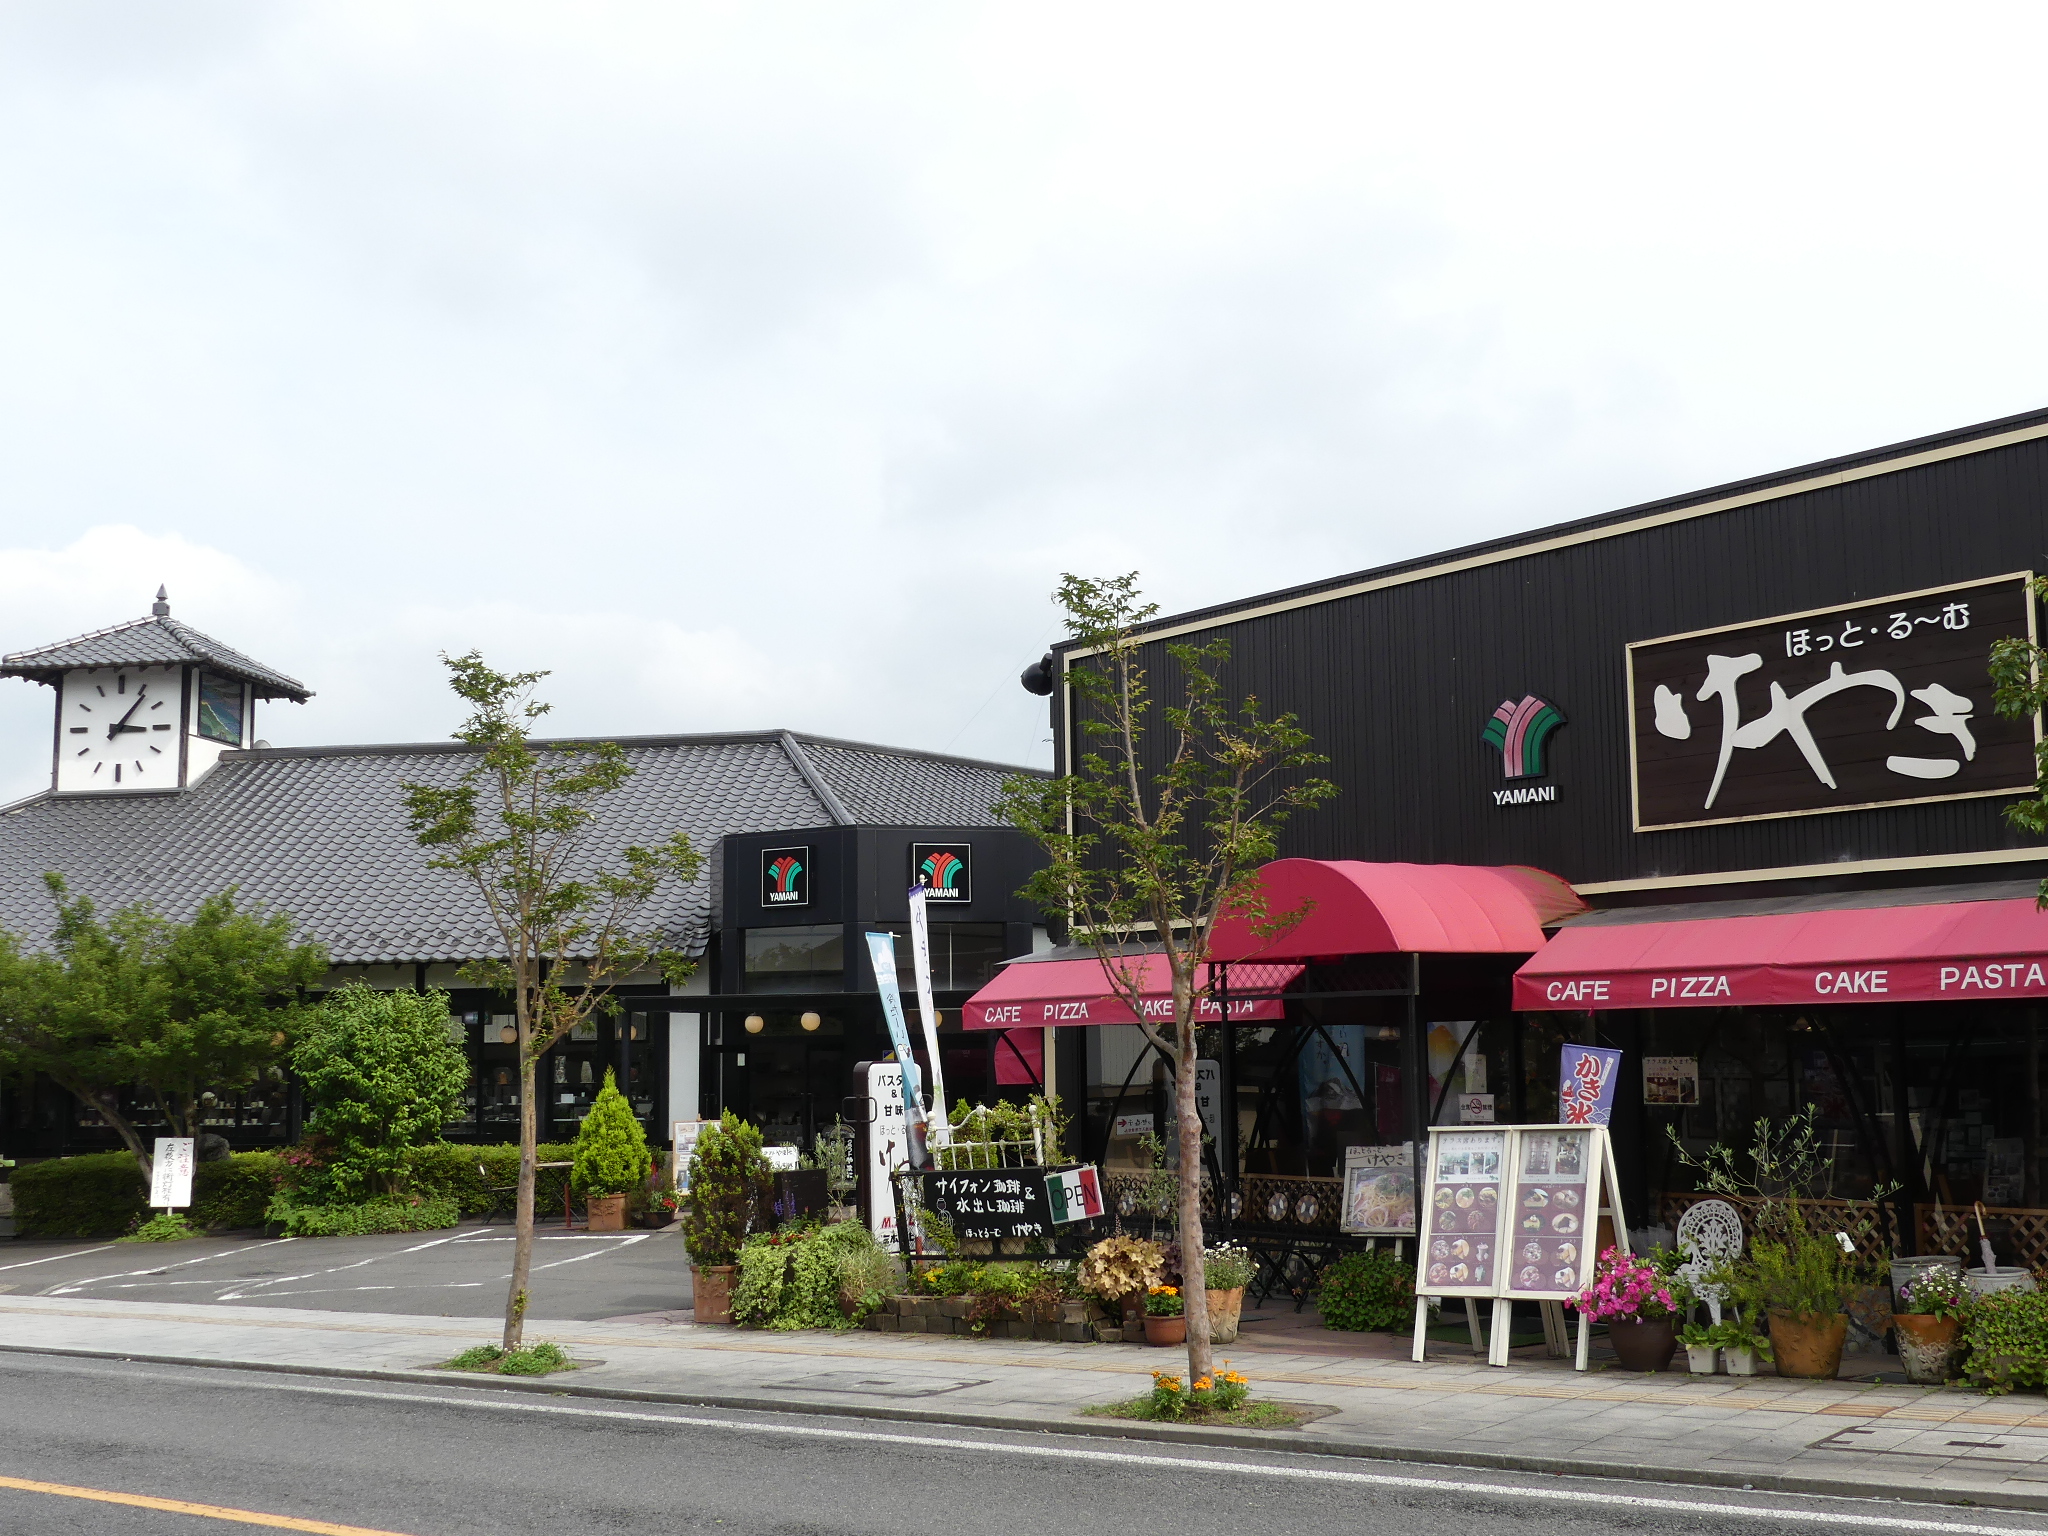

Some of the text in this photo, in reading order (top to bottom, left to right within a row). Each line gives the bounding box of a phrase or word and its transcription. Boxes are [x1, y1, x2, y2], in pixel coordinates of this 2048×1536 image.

[1653, 652, 1976, 810] けやき
[1493, 786, 1556, 806] YAMANI
[770, 891, 798, 902] YAMANI
[923, 887, 959, 898] YAMANI
[1546, 963, 2047, 1001] CAFE PIZZA CAKE PASTA
[984, 1006, 1022, 1022] CAFE
[1044, 1002, 1089, 1020] PIZZA
[1565, 1053, 1602, 1124] かき氷
[1025, 1187, 1036, 1200] &
[1051, 1182, 1098, 1211] OPEN
[956, 1197, 1024, 1214] 水出し珈琲
[1012, 1222, 1043, 1237] けやき
